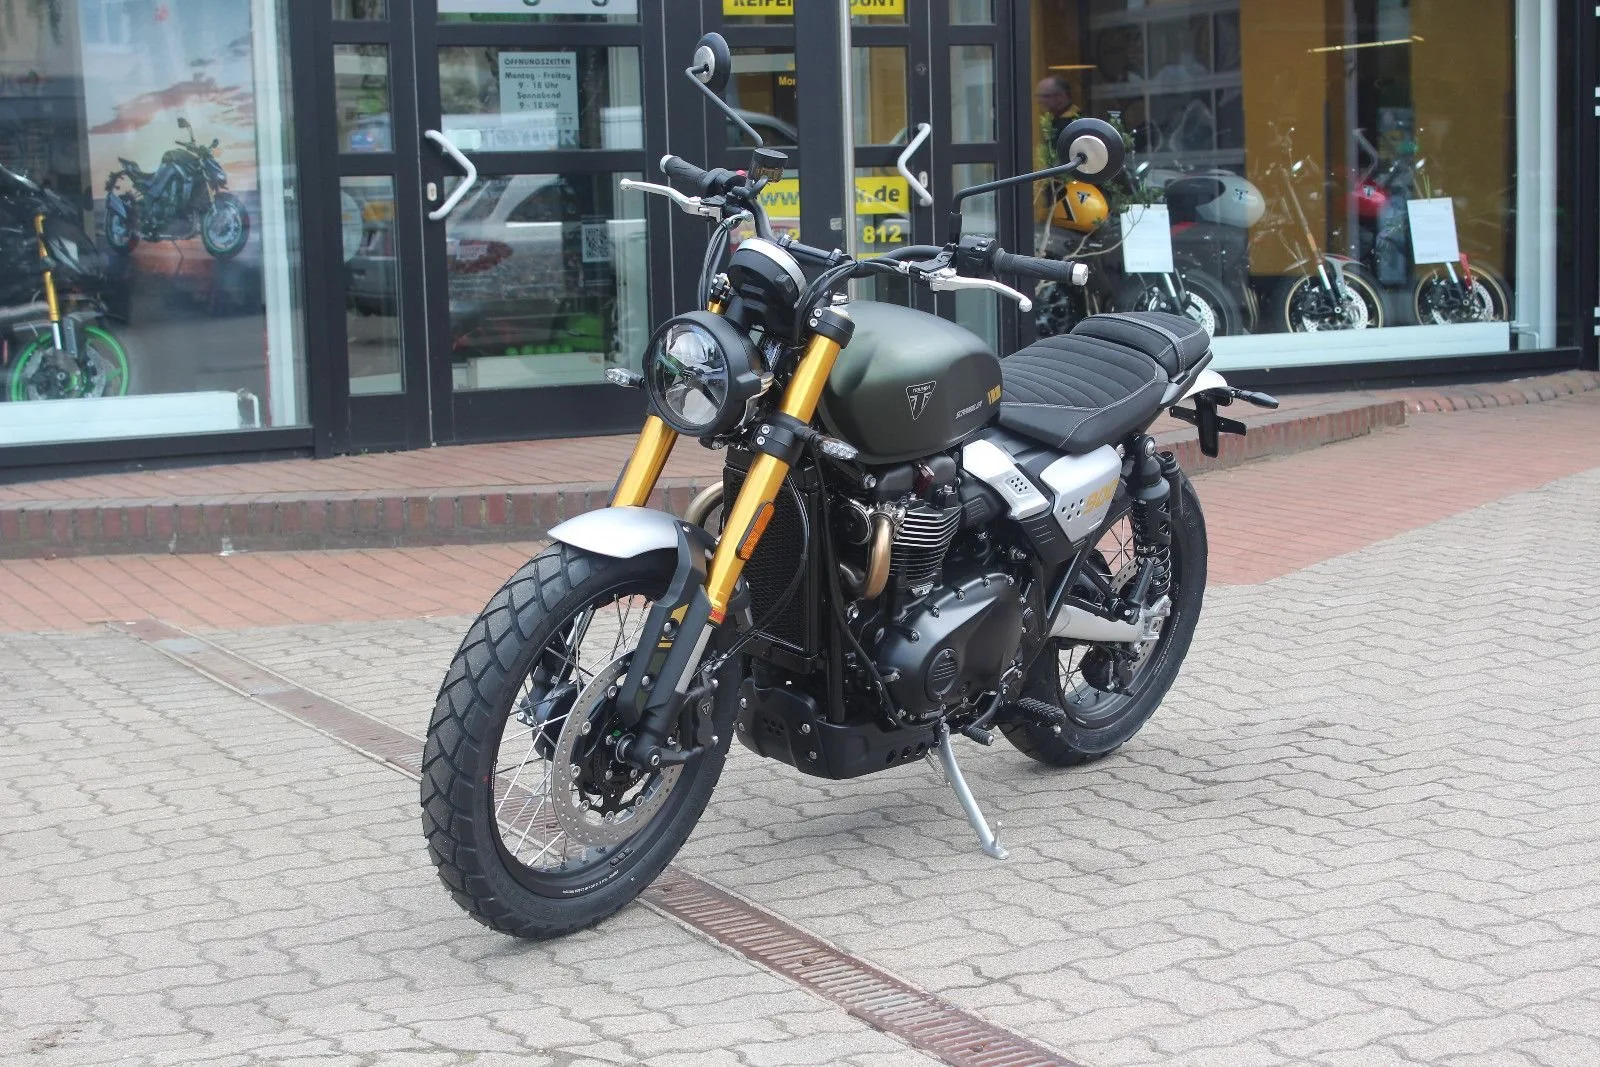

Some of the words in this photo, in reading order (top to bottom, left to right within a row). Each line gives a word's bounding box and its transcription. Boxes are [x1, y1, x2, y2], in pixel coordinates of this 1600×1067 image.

[504, 57, 571, 65] ÖFFNUNGSZEITEN
[505, 72, 535, 81] Montag
[543, 72, 571, 81] Freitag
[863, 222, 902, 244] 812
